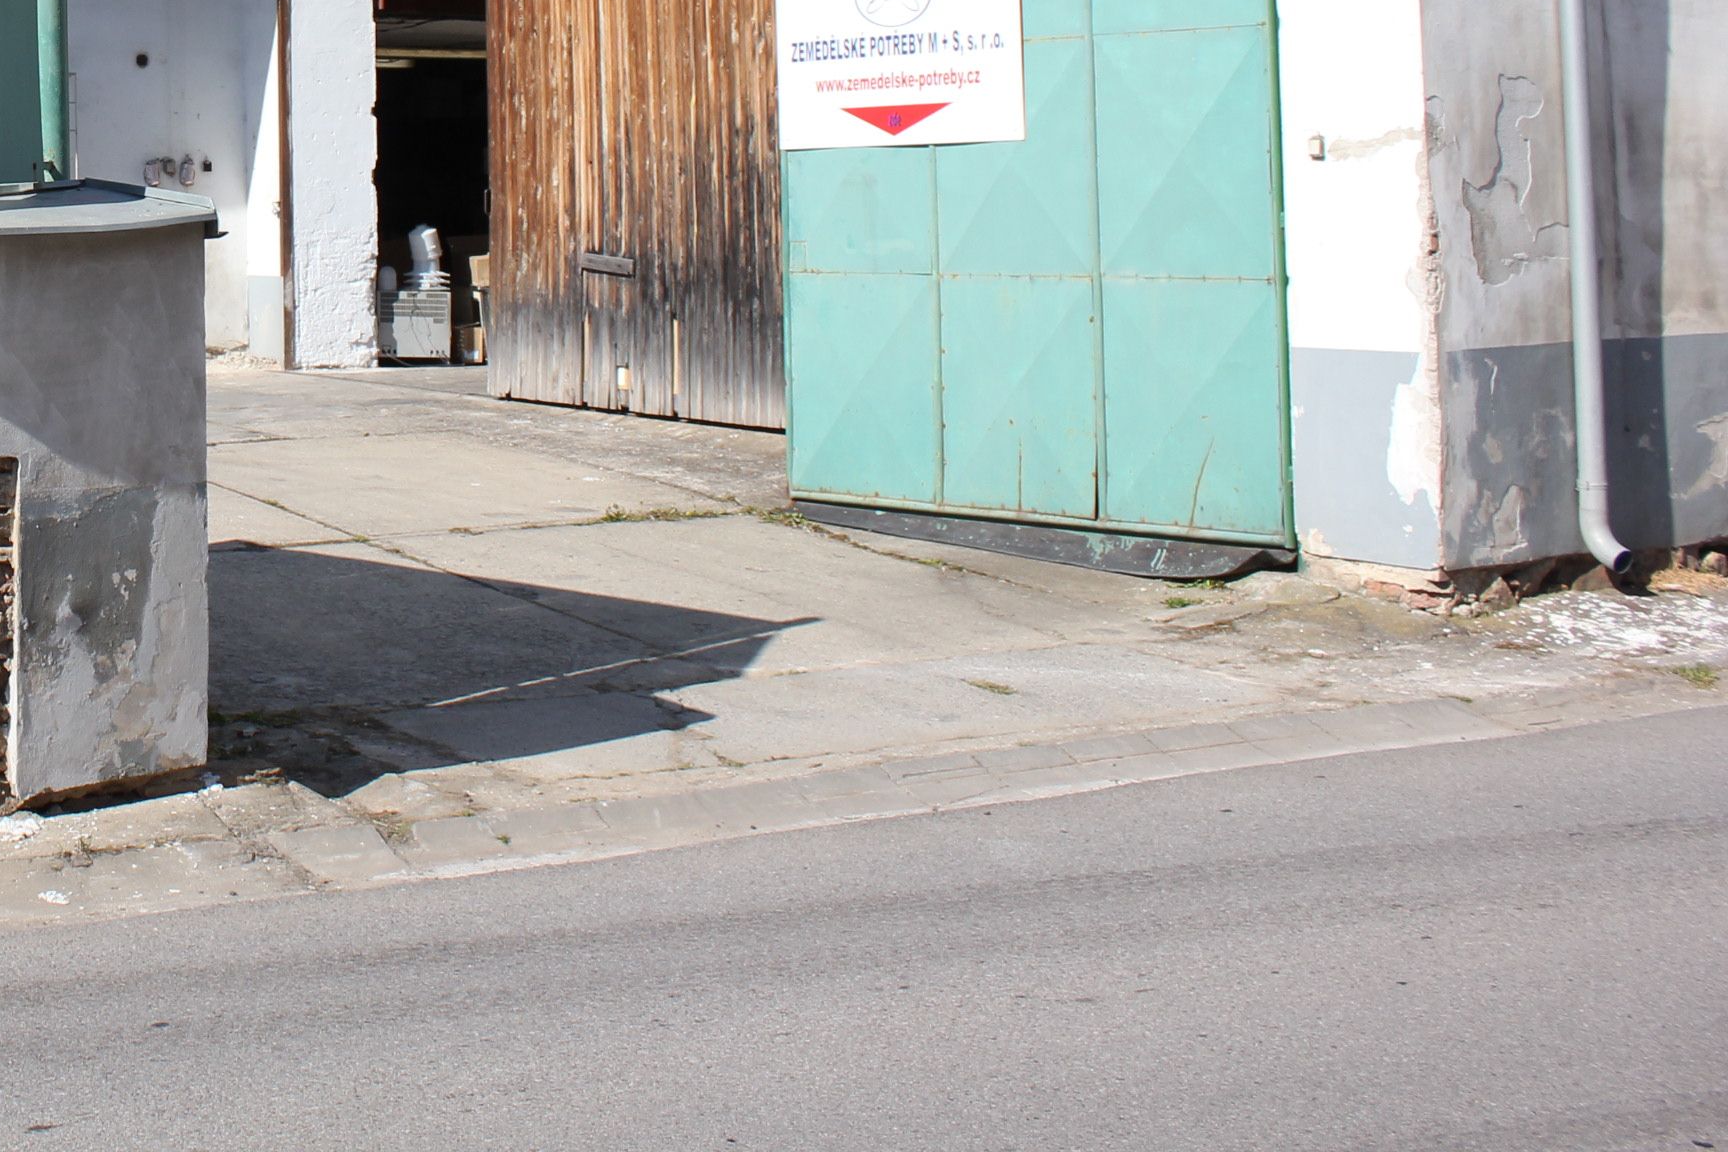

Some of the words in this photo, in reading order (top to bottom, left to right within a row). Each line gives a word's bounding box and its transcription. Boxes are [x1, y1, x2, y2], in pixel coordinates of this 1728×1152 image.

[791, 33, 866, 62] ZEMĚDĚLSKÉ
[870, 30, 924, 56] POTŘEBY
[928, 32, 938, 53] M
[816, 68, 981, 92] www.zemedelske-potreby.cz
